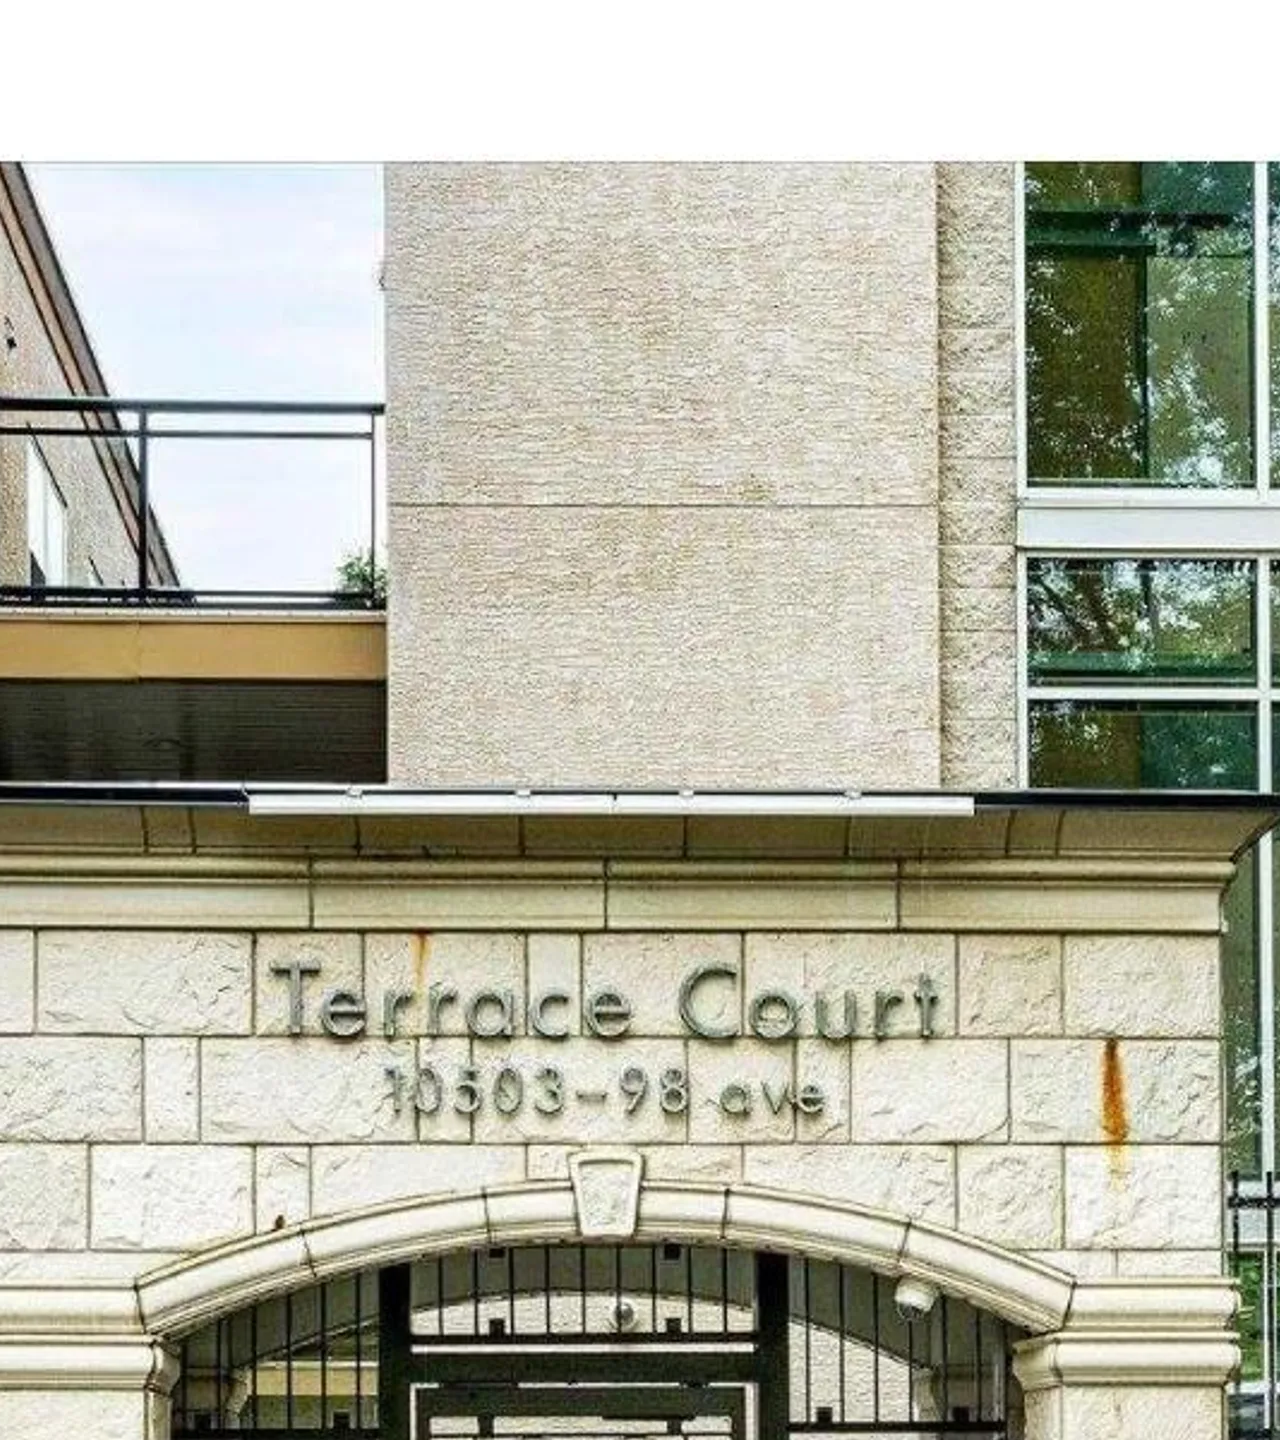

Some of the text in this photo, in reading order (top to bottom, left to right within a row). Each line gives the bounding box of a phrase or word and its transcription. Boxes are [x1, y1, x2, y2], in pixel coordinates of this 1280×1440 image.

[270, 960, 939, 1040] Terrace Court
[721, 1082, 825, 1114] ave
